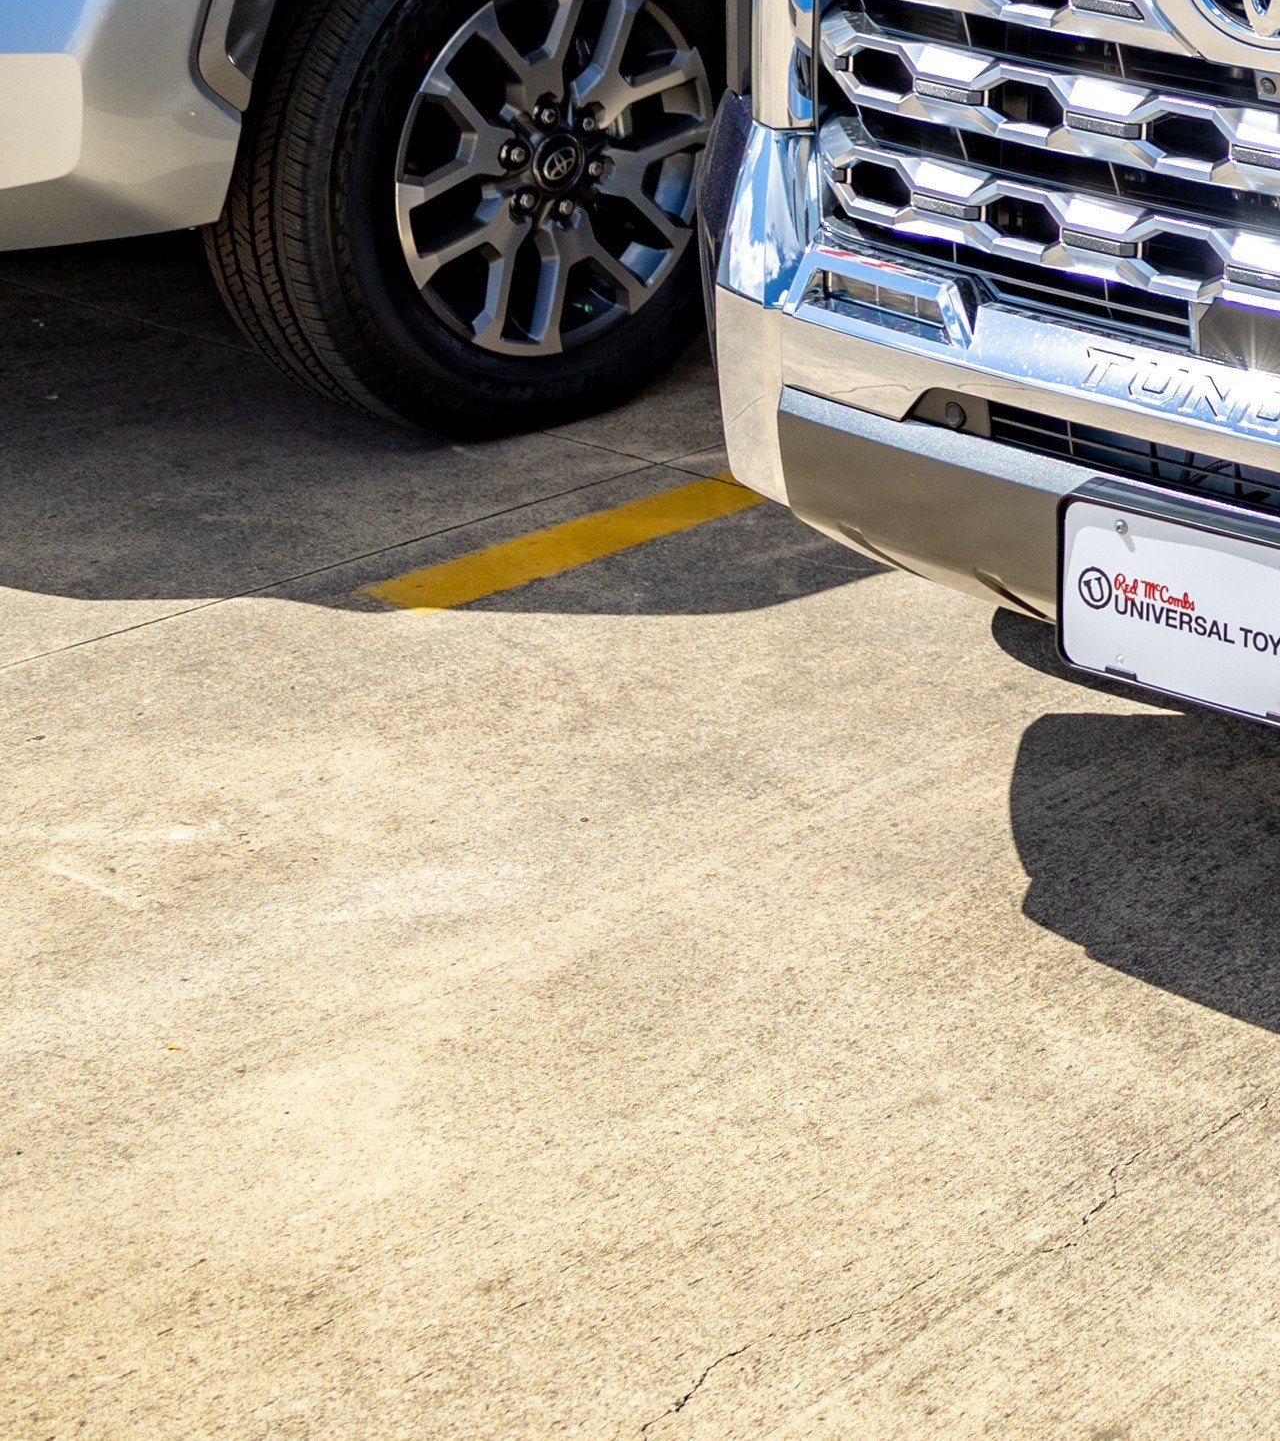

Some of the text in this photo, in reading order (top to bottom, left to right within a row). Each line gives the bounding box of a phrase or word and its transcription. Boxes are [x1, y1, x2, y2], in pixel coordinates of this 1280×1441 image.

[1114, 572, 1195, 612] Red McCombs
[1114, 594, 1235, 645] UNIVERSAL
